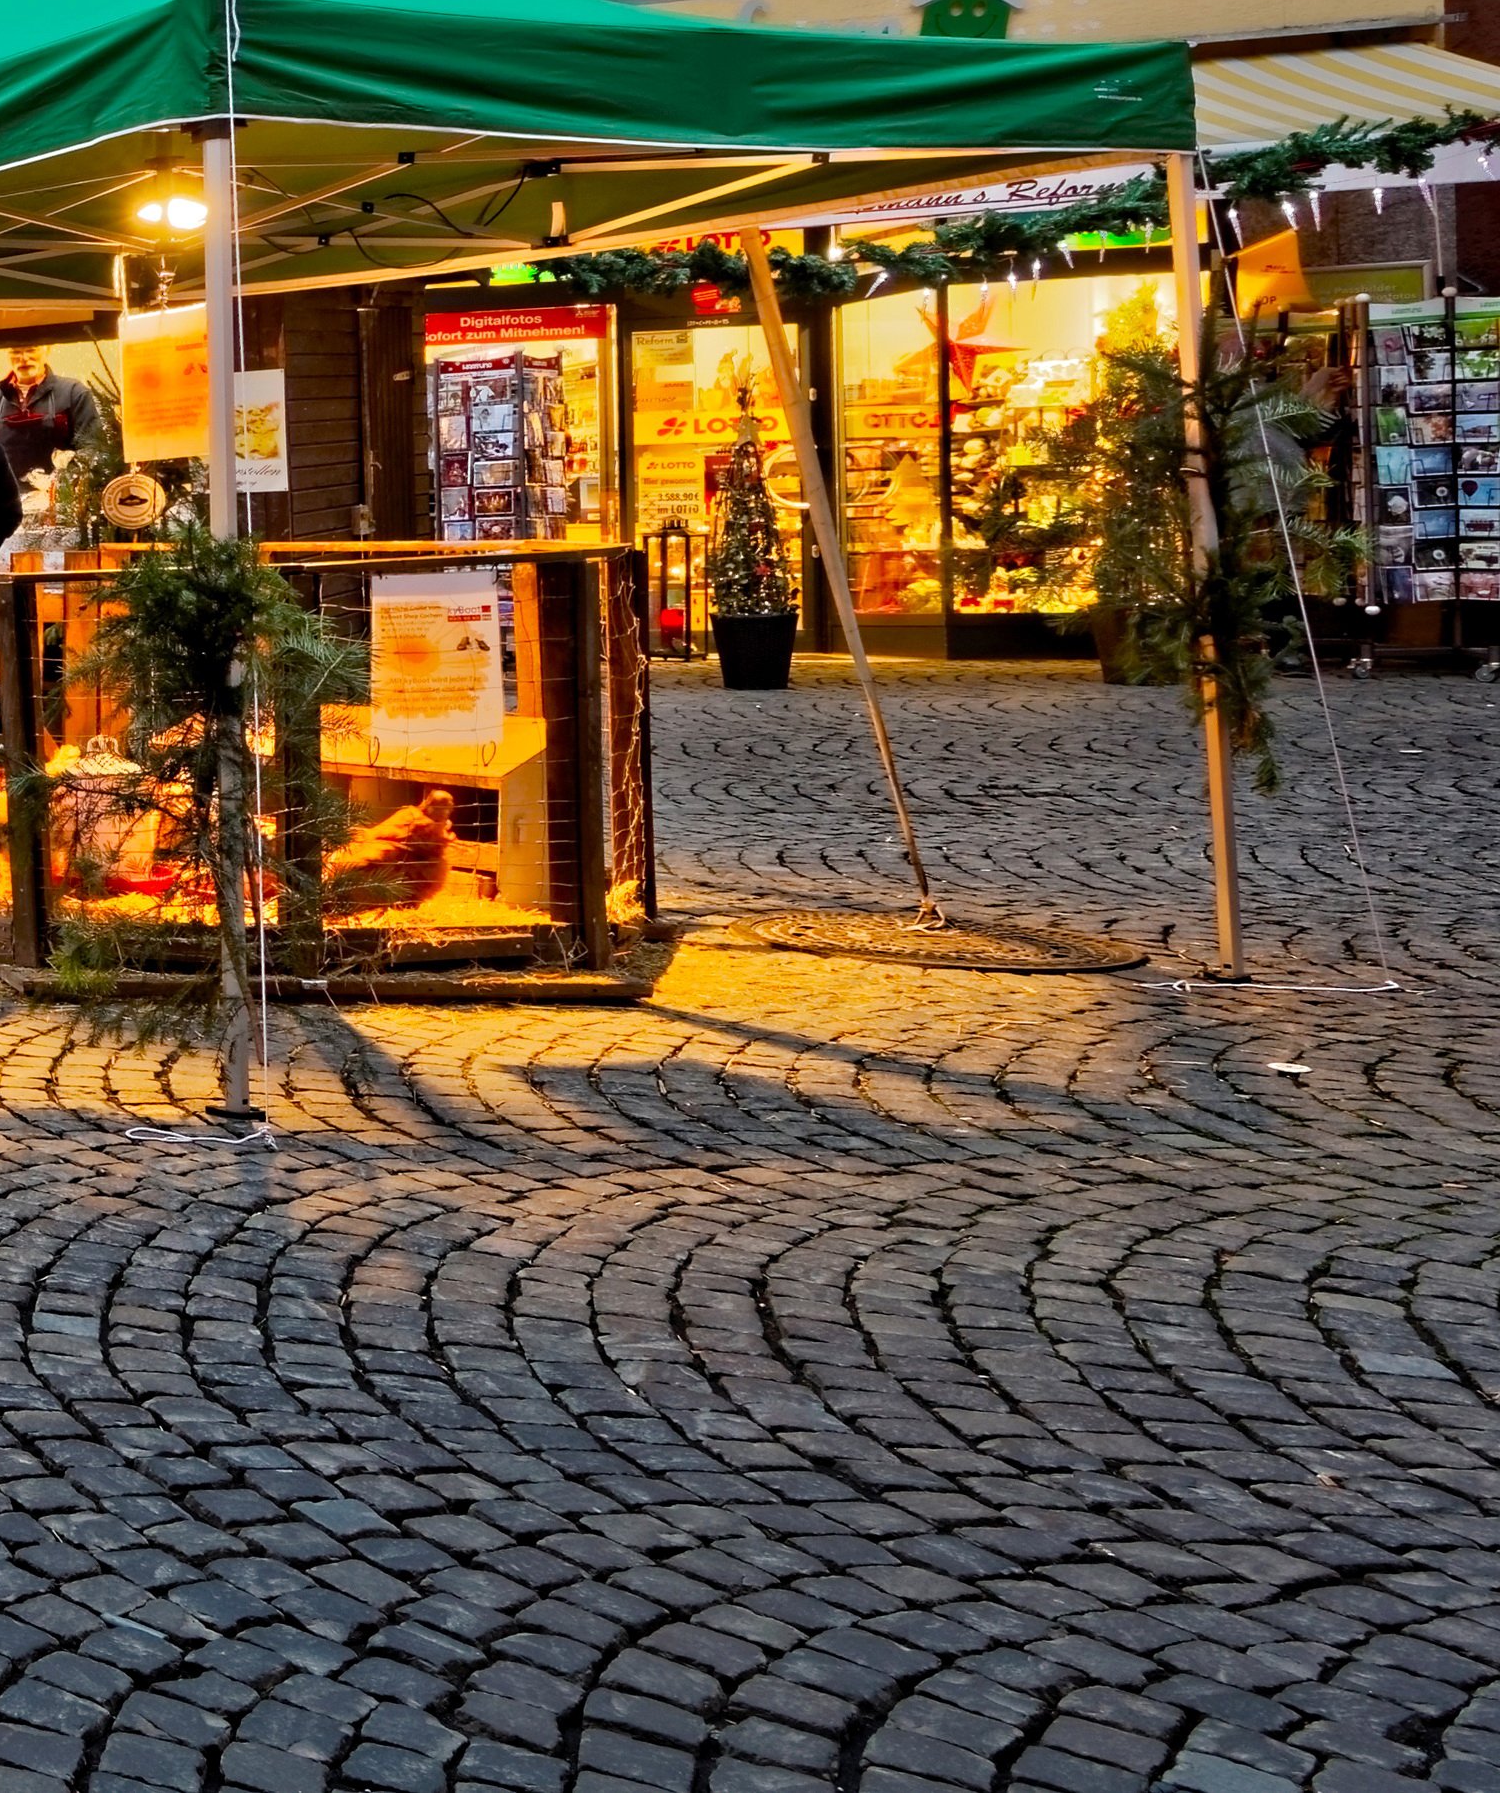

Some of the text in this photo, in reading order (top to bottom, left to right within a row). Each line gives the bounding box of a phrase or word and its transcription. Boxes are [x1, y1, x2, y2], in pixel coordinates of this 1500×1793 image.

[460, 314, 543, 329] Digitalfotos
[465, 331, 496, 340] zum
[500, 324, 585, 339] Mitnehmen!
[661, 461, 696, 469] LOTTO
